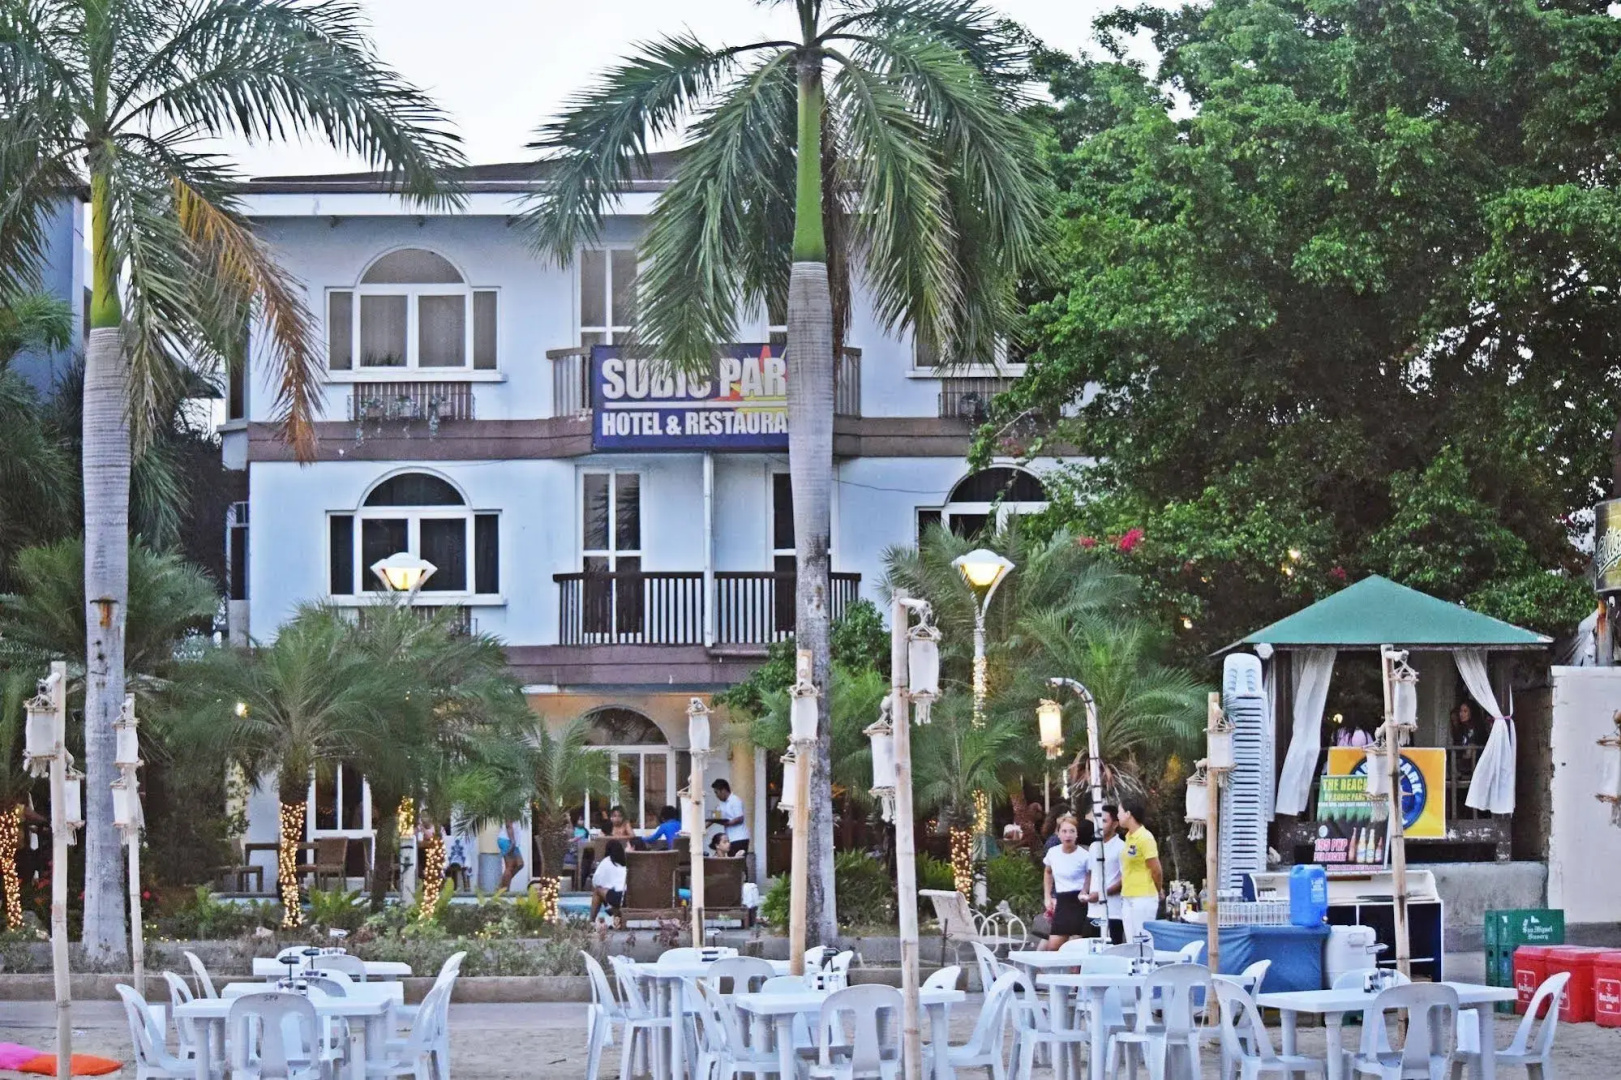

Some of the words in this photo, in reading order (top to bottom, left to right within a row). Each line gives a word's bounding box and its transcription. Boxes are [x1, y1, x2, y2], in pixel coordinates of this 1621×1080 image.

[602, 358, 711, 399] SUBIC
[720, 357, 788, 397] PAR
[602, 412, 662, 436] HOTEL
[666, 415, 682, 435] &
[686, 411, 789, 435] RESTAURA
[1323, 778, 1339, 791] THE
